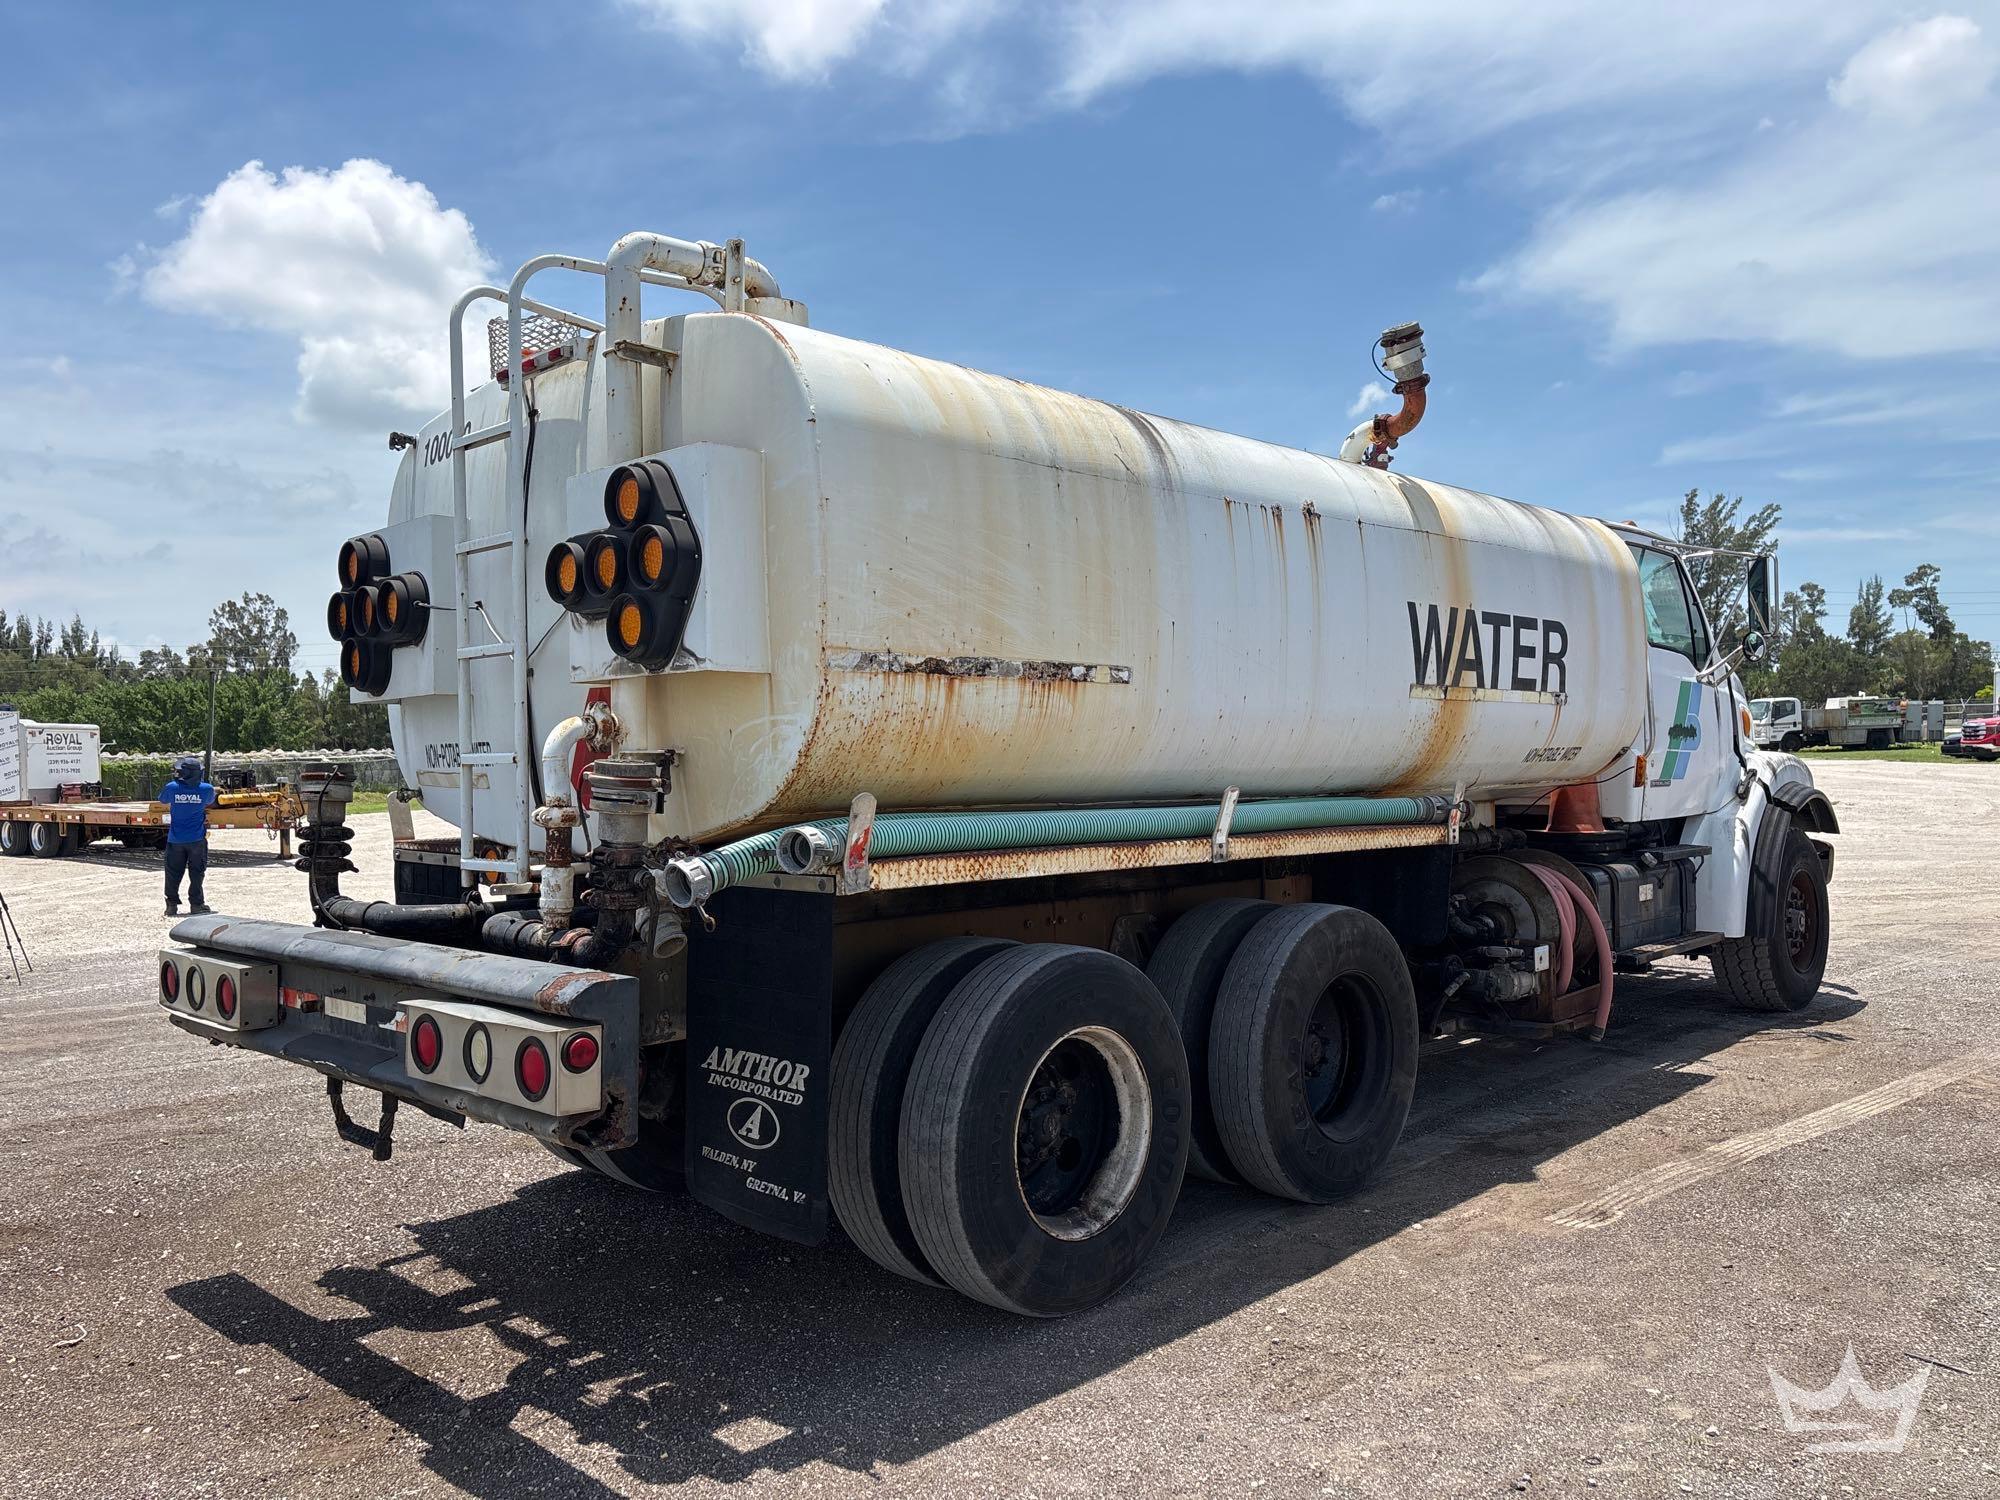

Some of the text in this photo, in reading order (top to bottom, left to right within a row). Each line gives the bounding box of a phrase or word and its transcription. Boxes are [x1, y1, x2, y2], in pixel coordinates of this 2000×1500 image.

[1407, 601, 1569, 693] WATER
[46, 733, 82, 745] ROYAL
[425, 742, 461, 769] NON-POTAB
[701, 1045, 810, 1091] AMTHOR
[707, 1073, 804, 1106] INCORPORATED
[737, 1104, 763, 1140] A
[701, 1146, 758, 1173] WALDEN, NY
[746, 1176, 790, 1201] GRETNA,
